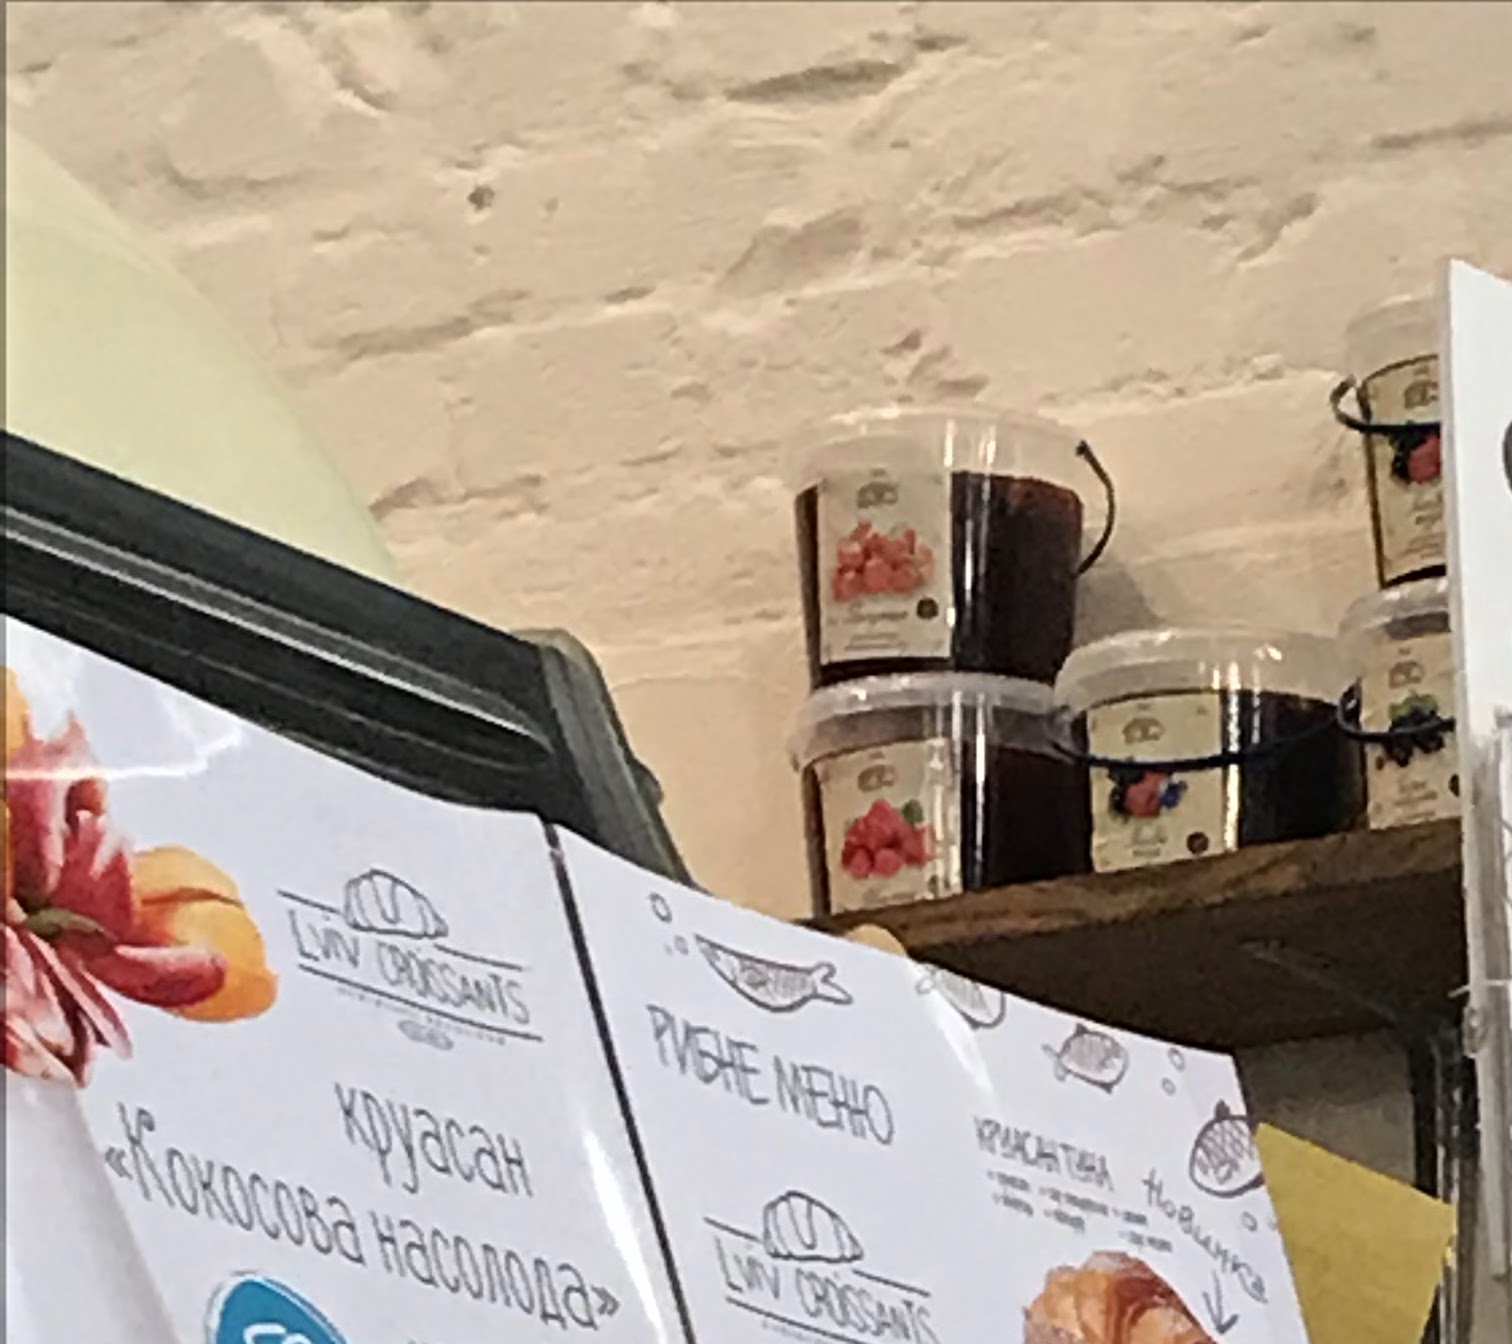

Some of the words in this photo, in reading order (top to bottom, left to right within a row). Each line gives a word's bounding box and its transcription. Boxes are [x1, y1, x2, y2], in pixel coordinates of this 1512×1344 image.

[289, 908, 361, 968] LVIV
[376, 945, 533, 1028] CROISSANTS
[333, 1083, 533, 1197] круасан
[773, 1055, 896, 1146] МЕНЮ
[715, 1236, 781, 1300] LVIV
